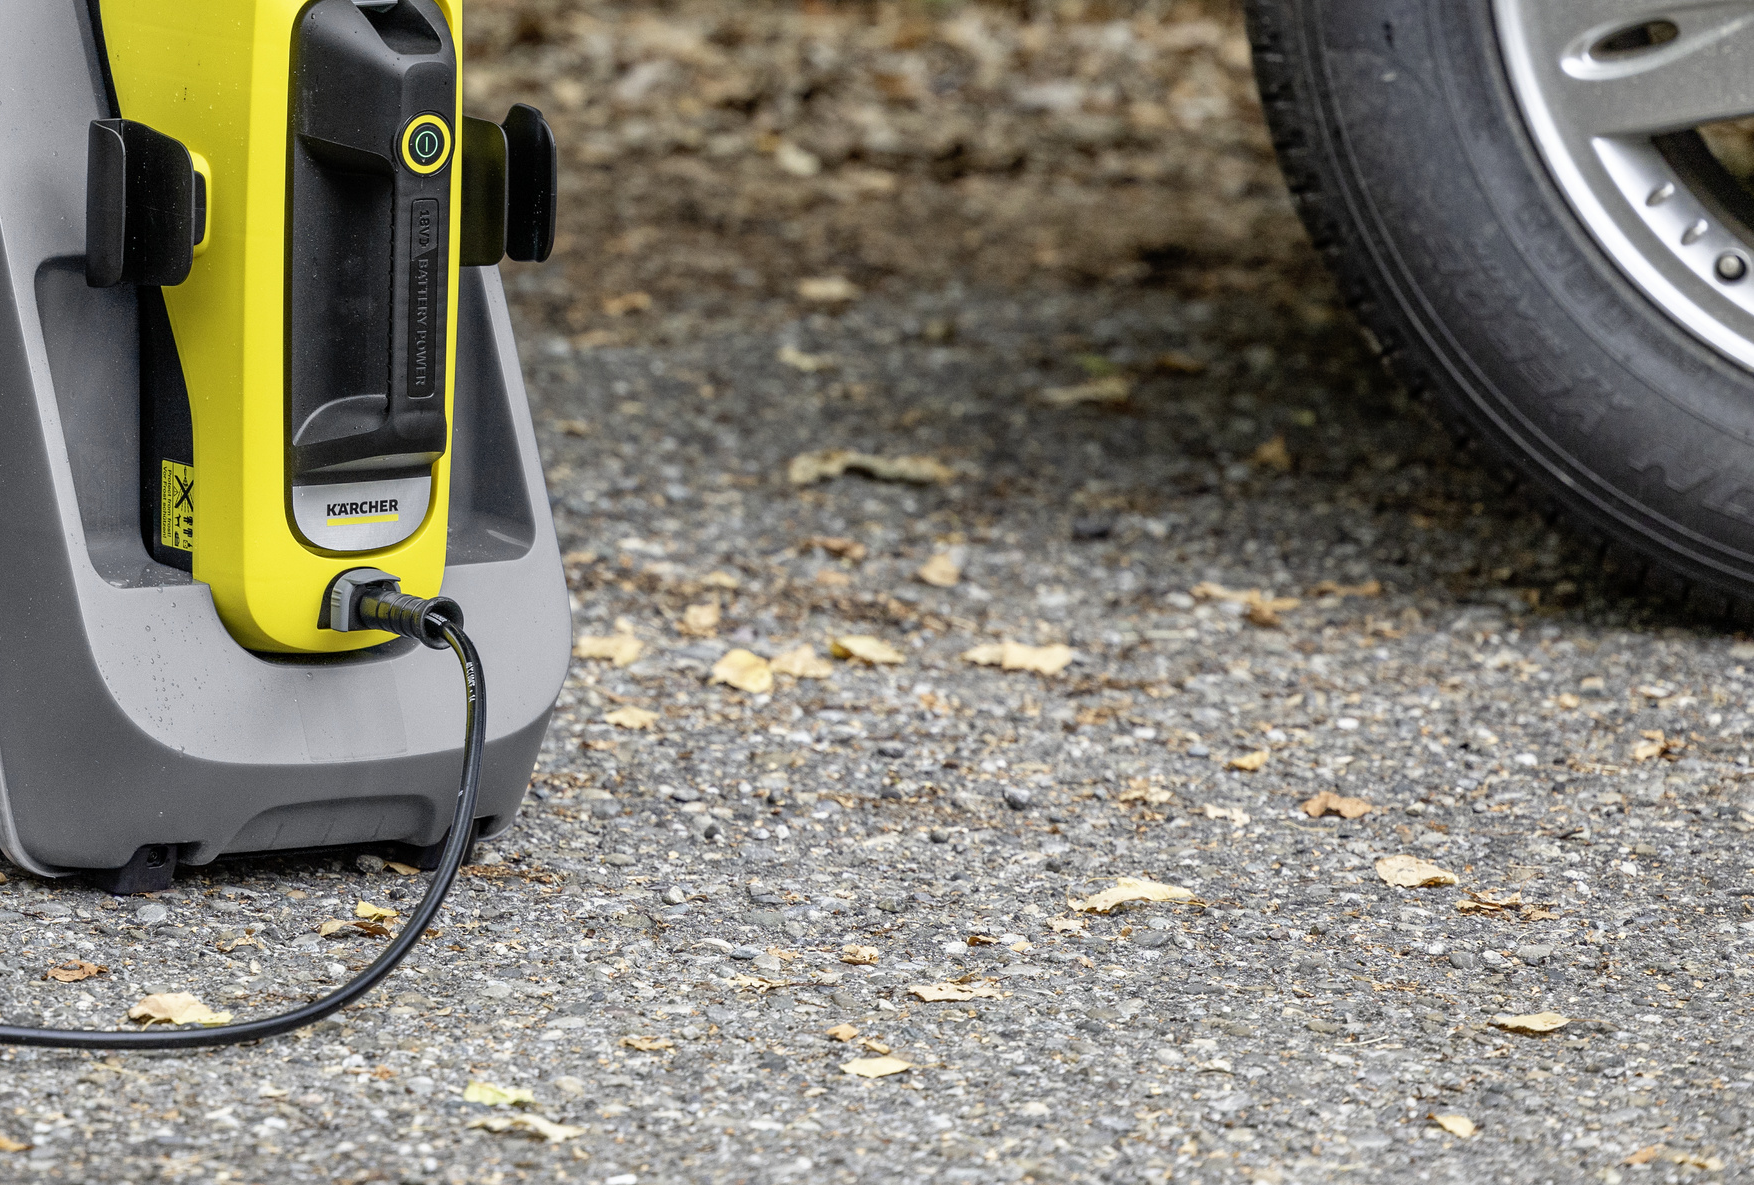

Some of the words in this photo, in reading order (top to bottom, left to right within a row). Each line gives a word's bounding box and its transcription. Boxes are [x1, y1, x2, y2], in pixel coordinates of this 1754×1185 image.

[415, 258, 430, 326] BATTERY
[414, 330, 428, 386] POWER
[326, 498, 399, 517] KÄRCHER
